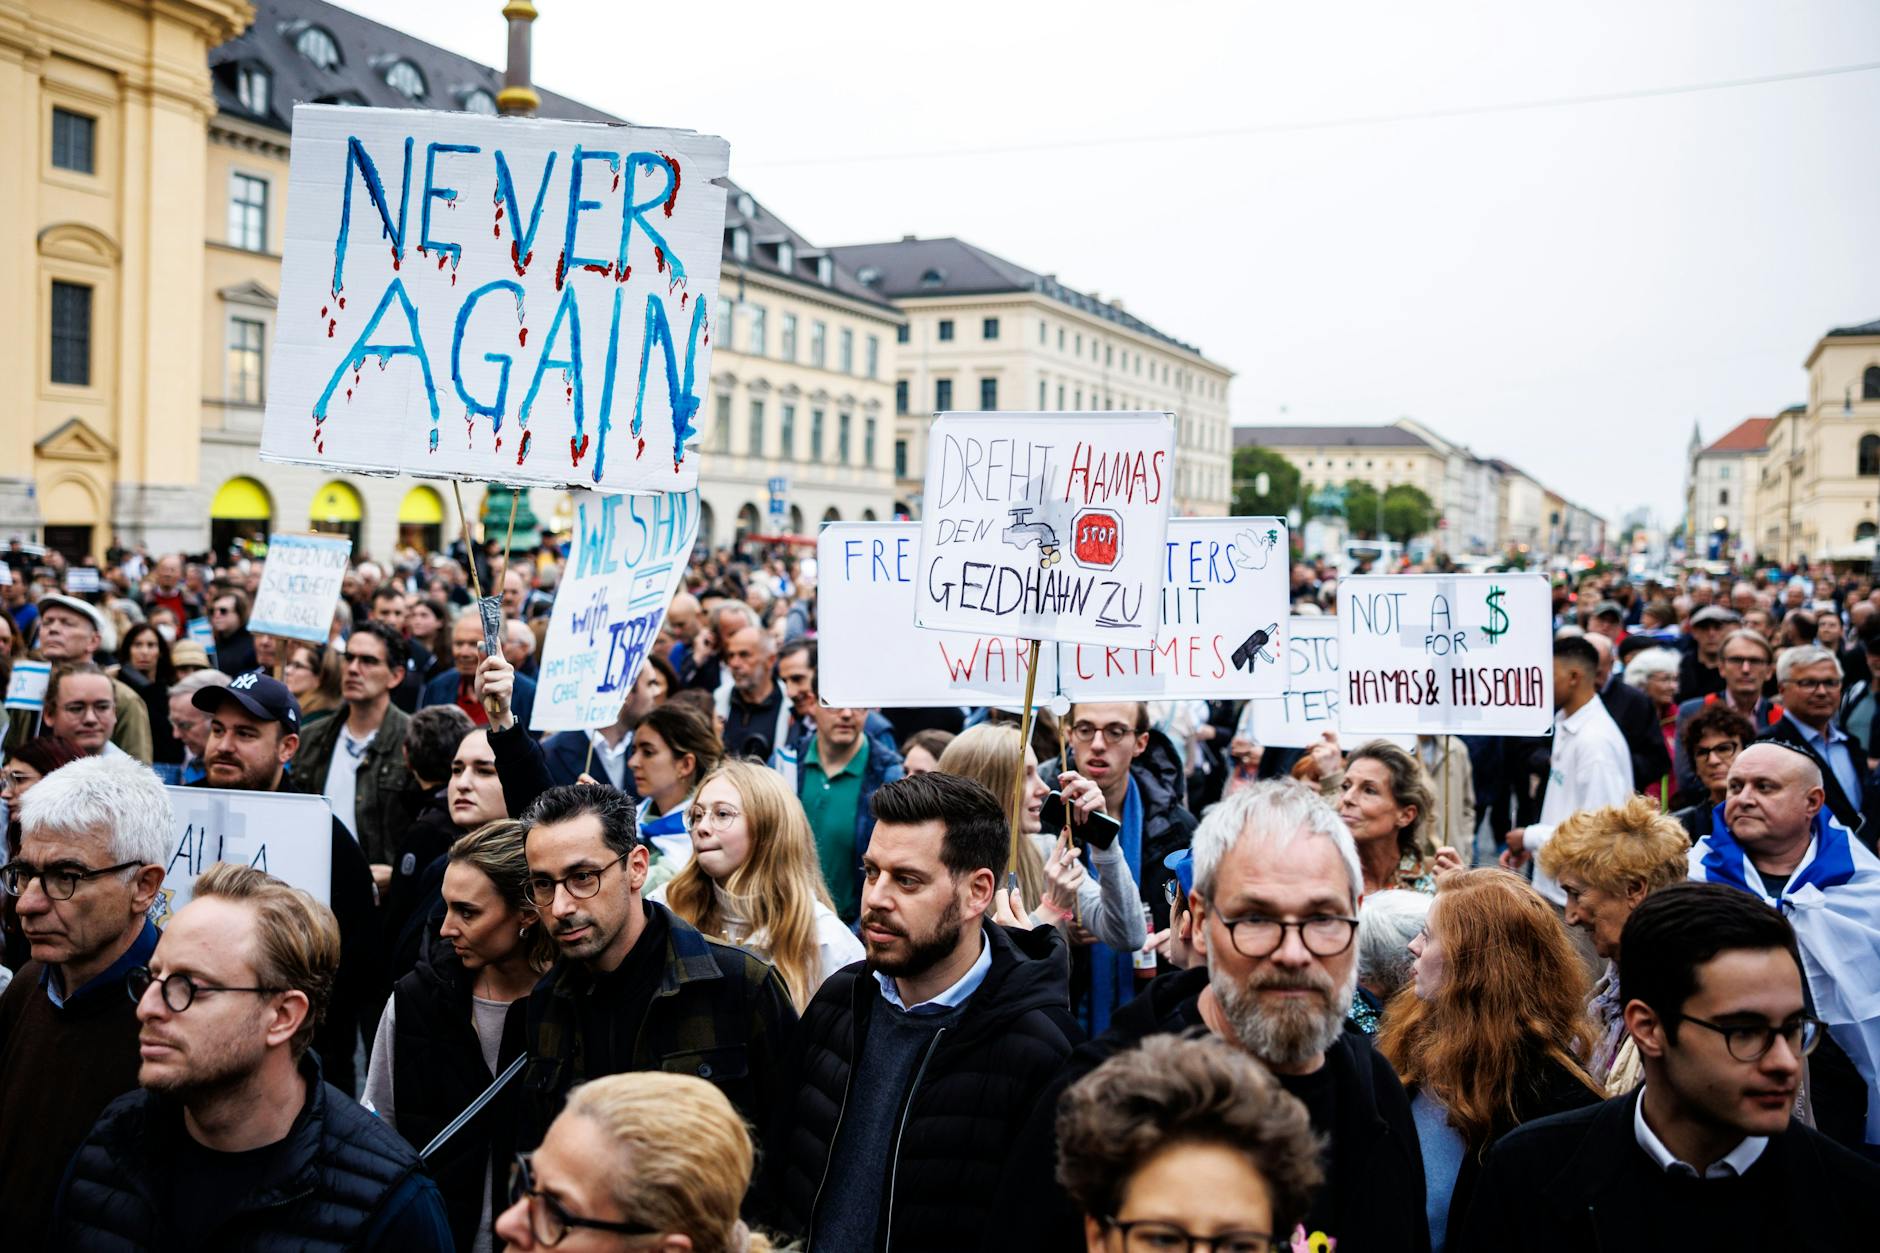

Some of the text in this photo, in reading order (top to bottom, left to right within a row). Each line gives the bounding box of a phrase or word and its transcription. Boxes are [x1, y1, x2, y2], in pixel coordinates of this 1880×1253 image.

[333, 135, 687, 299] NEVER
[313, 278, 708, 484] AGAIN
[938, 434, 1165, 509] DREHT HAMAS
[575, 494, 623, 580] WE
[936, 518, 995, 546] DEN
[1081, 526, 1116, 545] STOP
[845, 538, 1237, 584] FRE TERS
[929, 555, 1143, 624] GELDHAHN ZU
[1351, 585, 1510, 645] NOT A $
[938, 634, 1226, 683] WAR CRIMES
[1289, 637, 1339, 676] STO
[1425, 631, 1468, 656] FOR
[1282, 688, 1339, 723] TER
[1452, 666, 1544, 708] HISBOLLA
